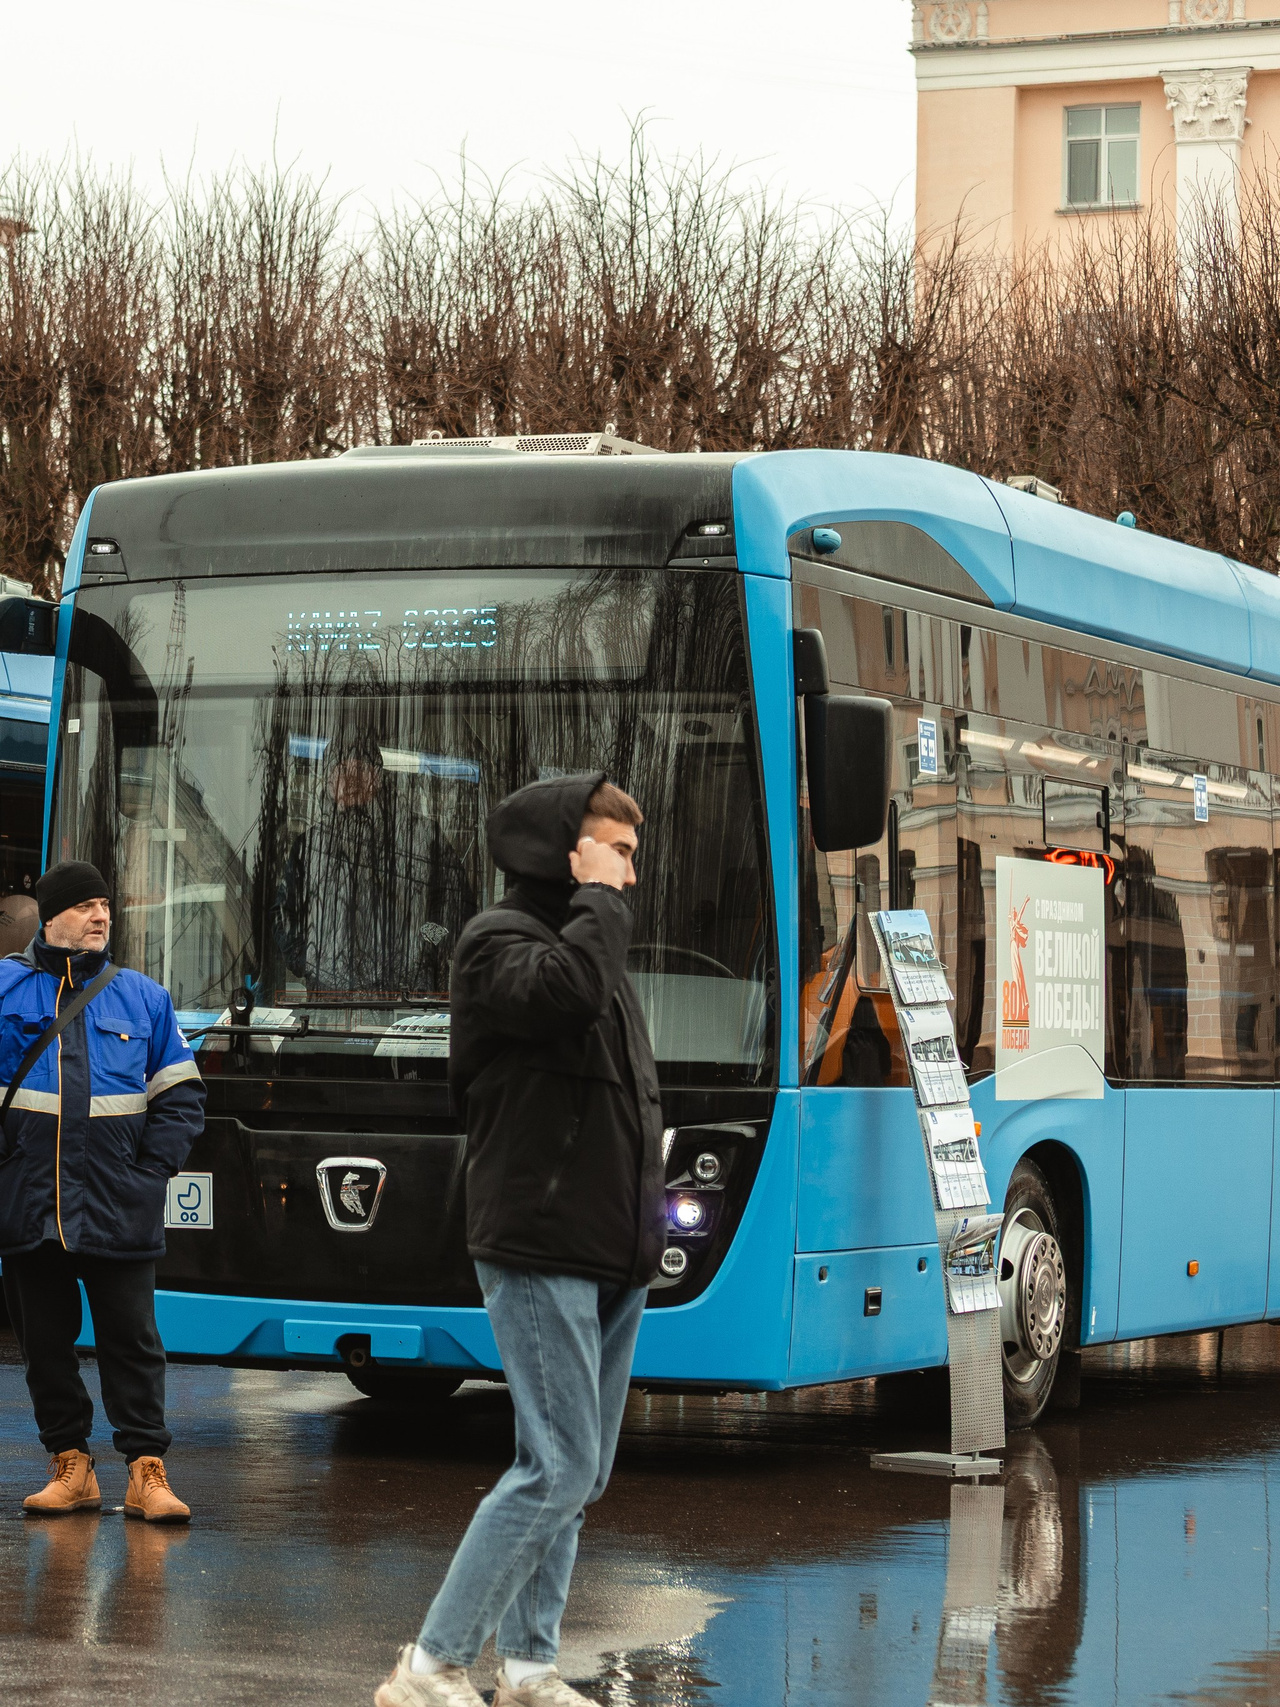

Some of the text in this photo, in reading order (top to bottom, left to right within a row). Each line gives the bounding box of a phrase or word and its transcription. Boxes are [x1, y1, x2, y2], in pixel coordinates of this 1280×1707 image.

[1035, 899, 1084, 923] С ПРАЗДНИКОМ
[1035, 928, 1100, 979] ВЕЛИКОЙ
[1035, 983, 1100, 1037] ПОБЕДЫ!
[1001, 1028, 1030, 1053] ПОБЕДА!
